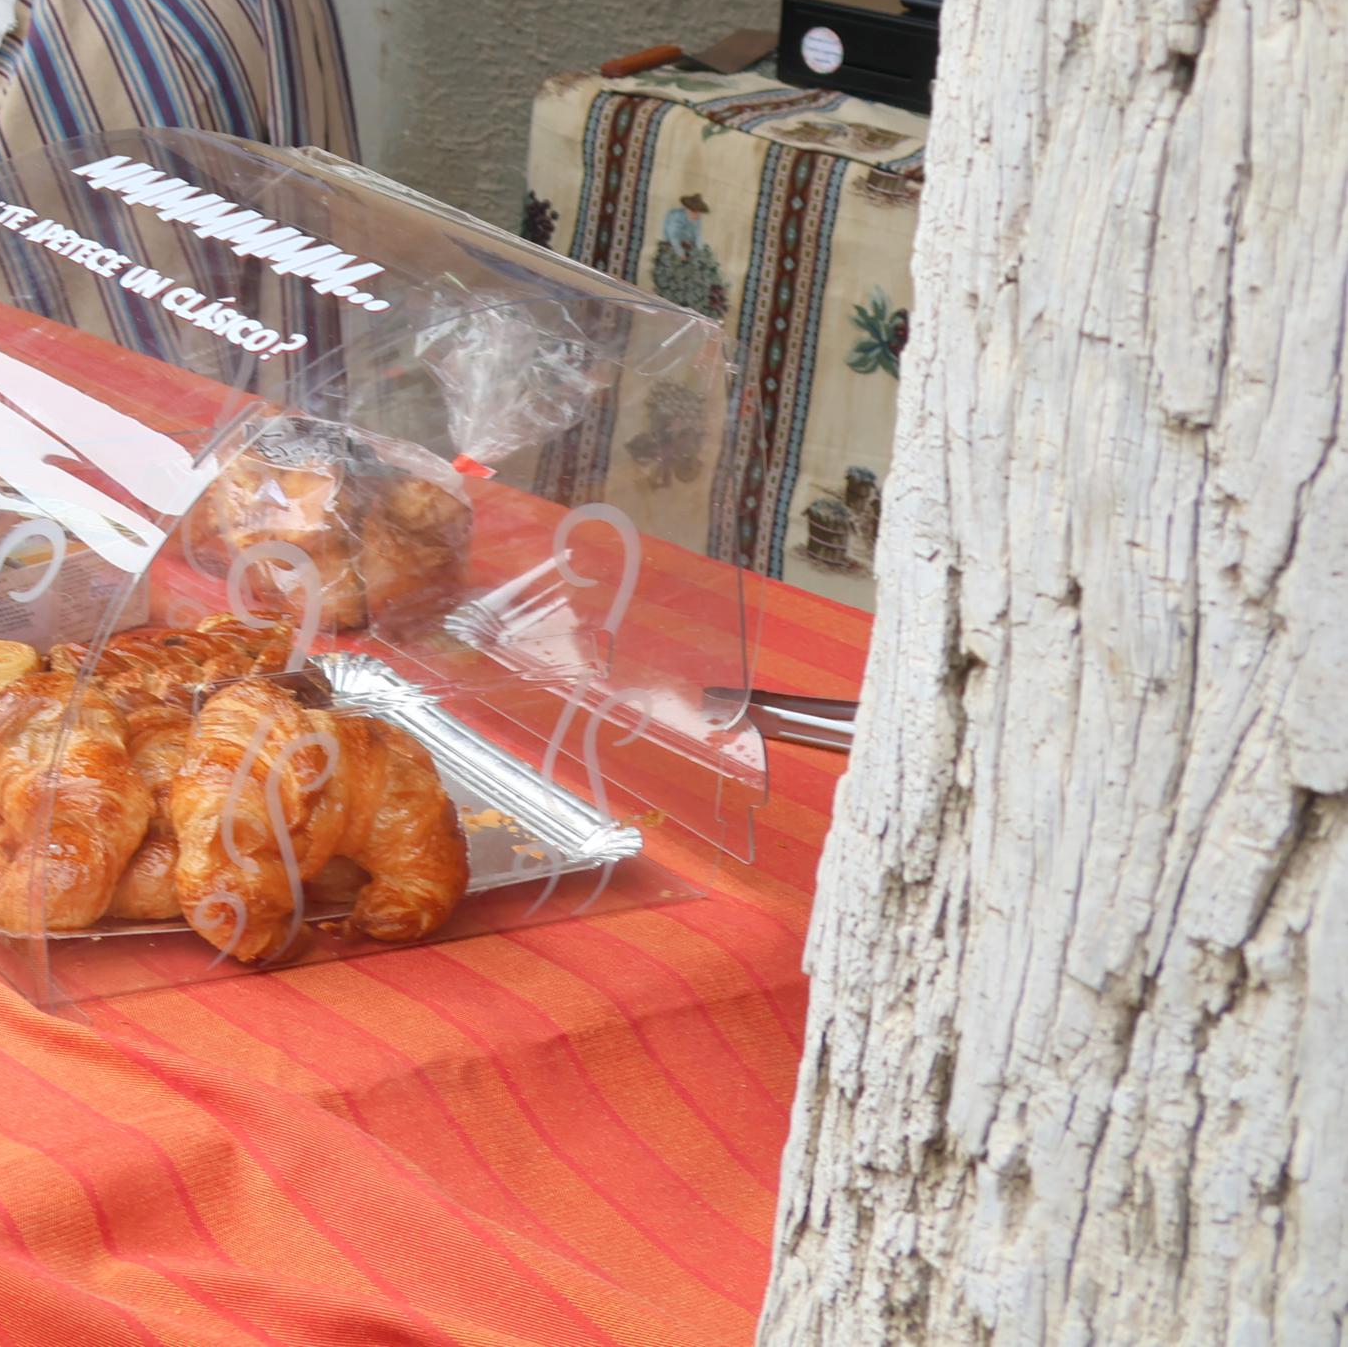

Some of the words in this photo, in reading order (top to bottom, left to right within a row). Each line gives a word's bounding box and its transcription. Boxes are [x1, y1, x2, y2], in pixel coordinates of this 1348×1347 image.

[18, 218, 133, 279] APETECE
[119, 262, 175, 299] UN
[160, 296, 309, 361] CLÁSICO?
